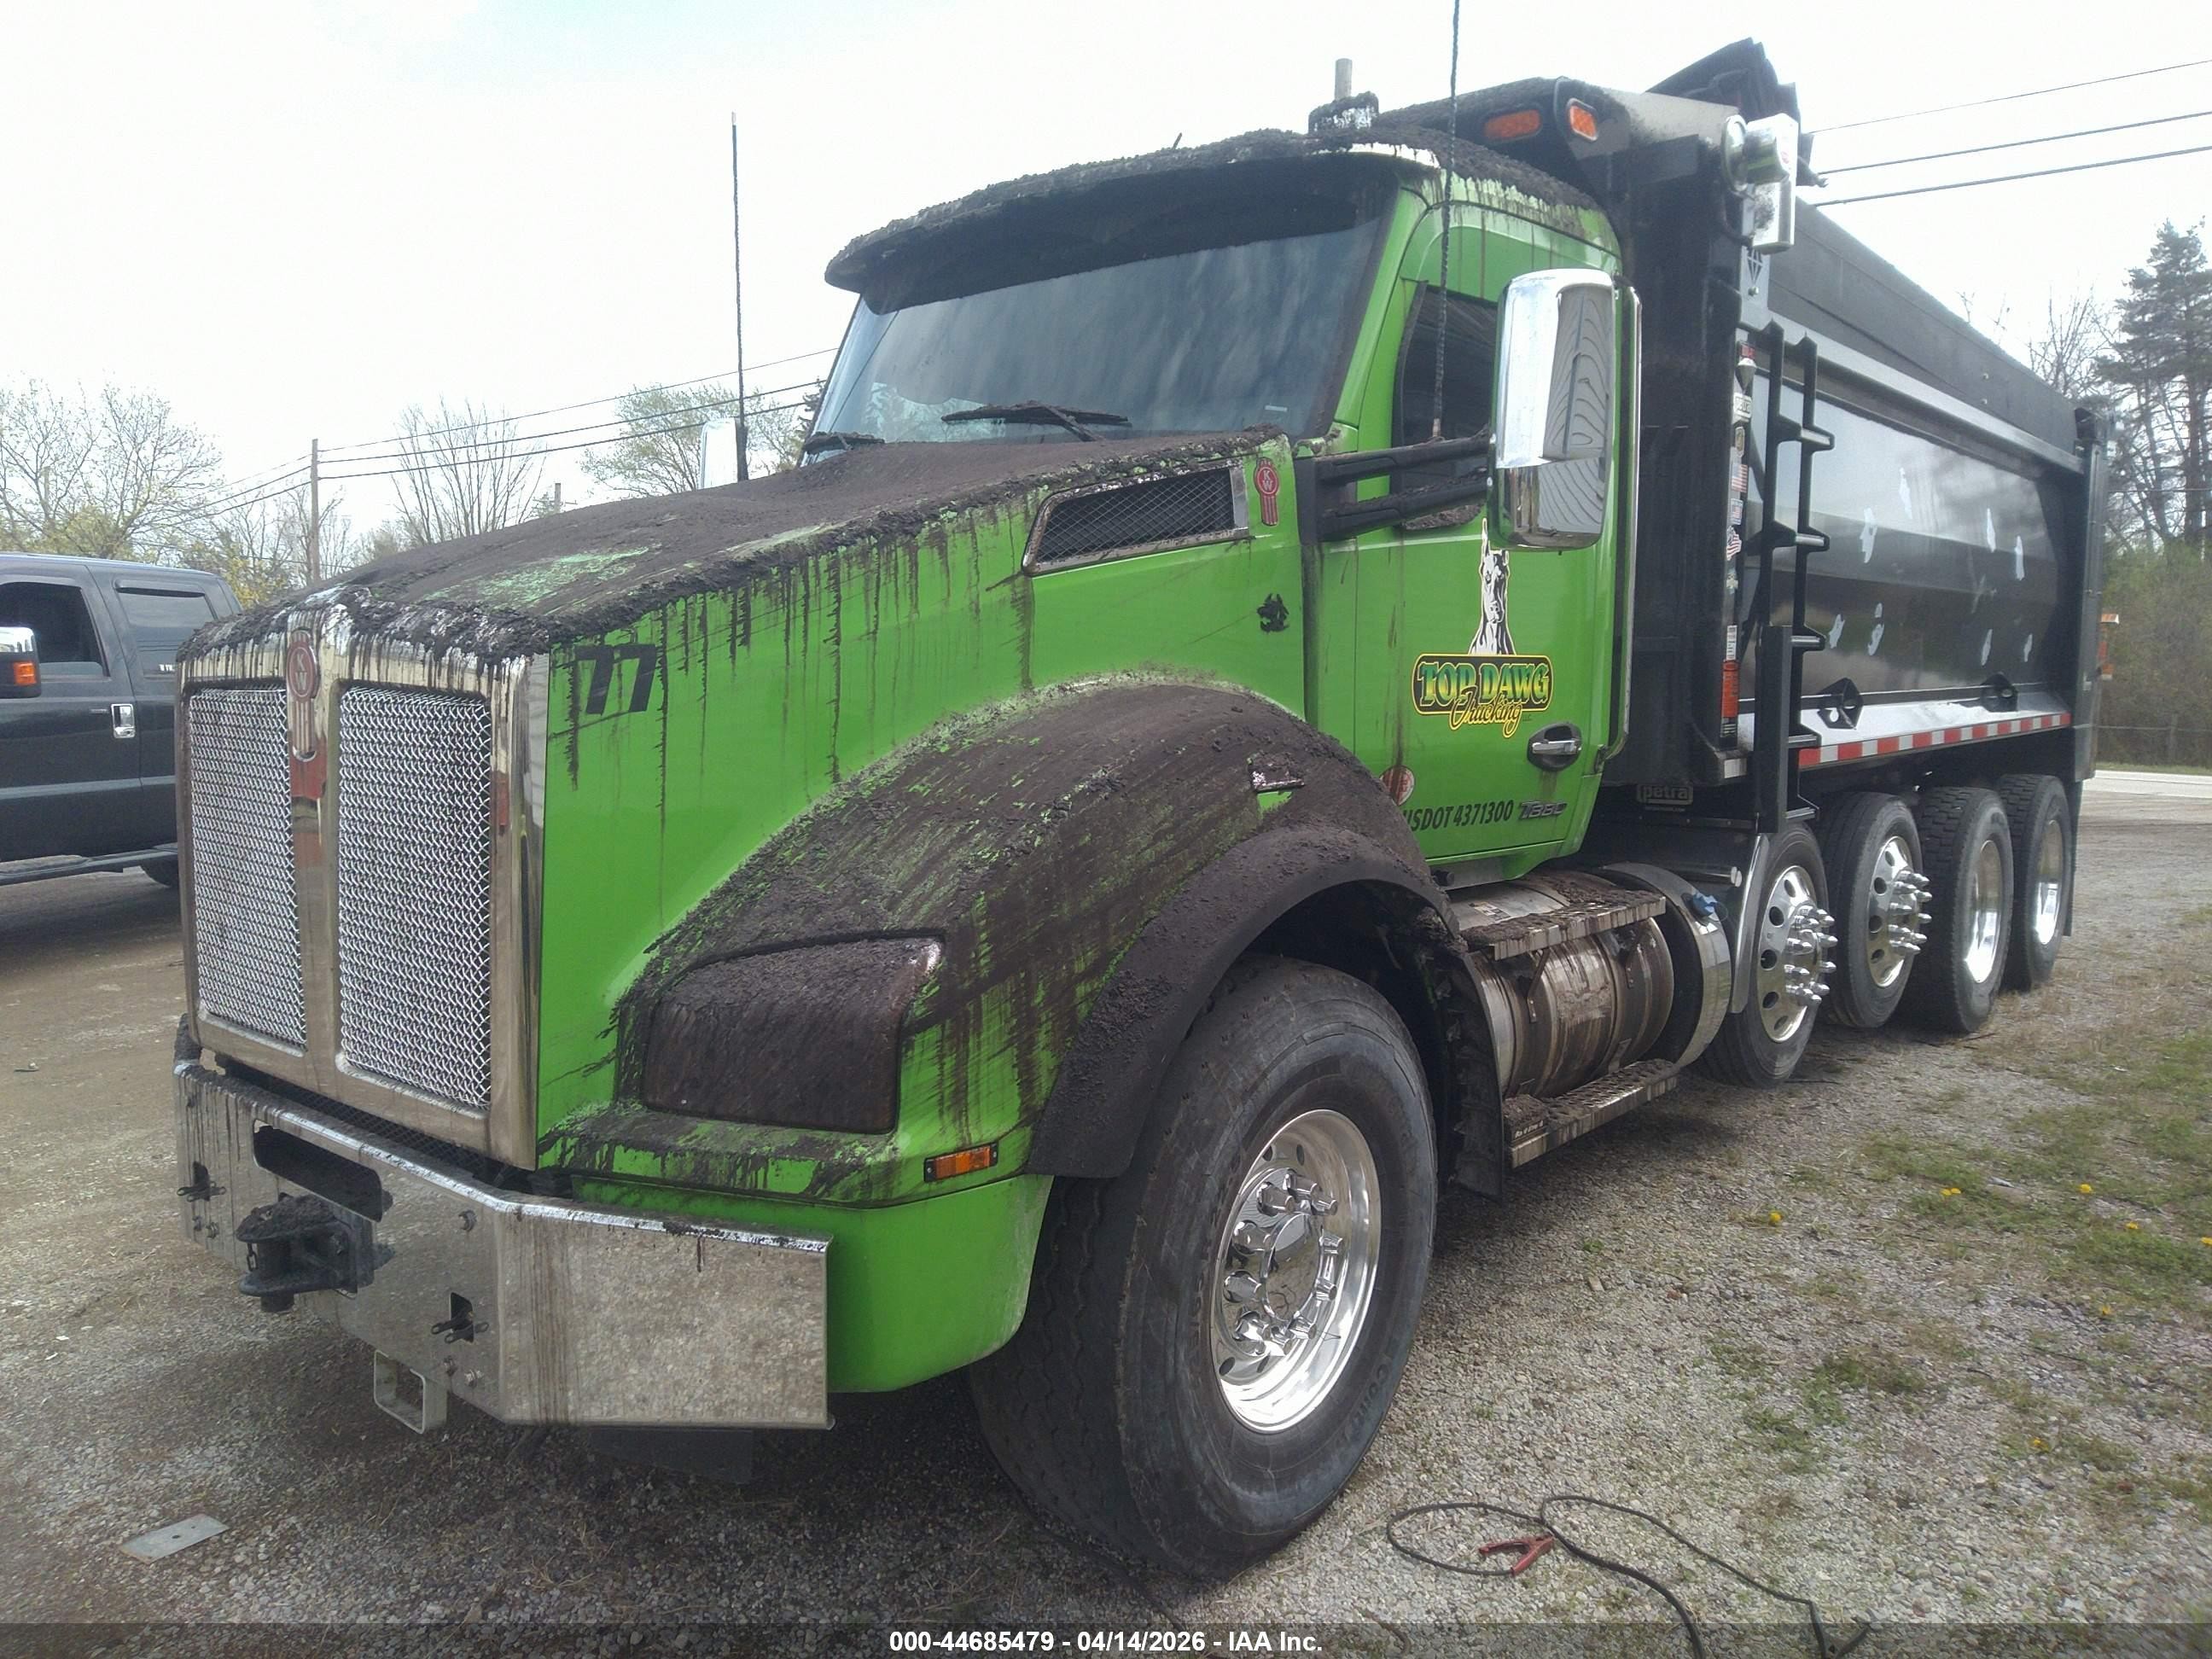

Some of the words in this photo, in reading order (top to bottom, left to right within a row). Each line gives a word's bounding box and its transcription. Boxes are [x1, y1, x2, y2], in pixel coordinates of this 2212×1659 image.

[573, 643, 656, 715] 77
[1417, 661, 1476, 707] TOP
[1478, 663, 1549, 704] DAWG
[1449, 685, 1522, 737] Trucking
[1403, 806, 1454, 831] USDOT
[1453, 800, 1514, 826] 4371300
